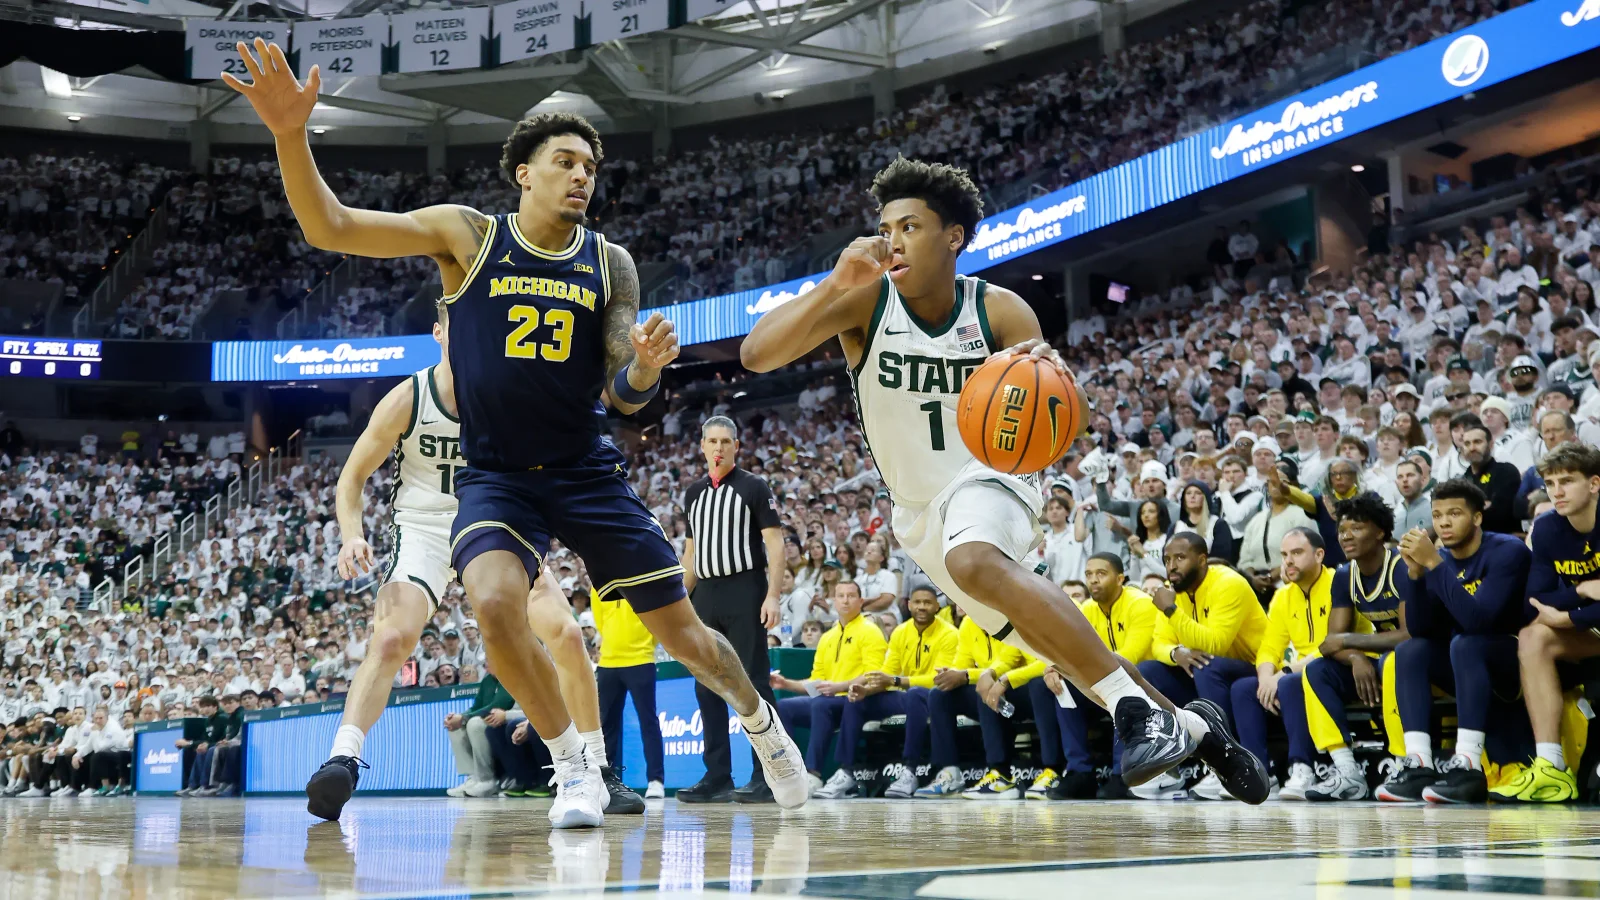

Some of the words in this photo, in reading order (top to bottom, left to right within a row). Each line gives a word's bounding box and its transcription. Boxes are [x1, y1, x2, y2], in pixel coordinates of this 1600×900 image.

[516, 1, 559, 19] SHAWN
[318, 26, 365, 38] MORRIS
[415, 18, 465, 31] MATEEN
[513, 13, 562, 33] RESPERT
[620, 14, 639, 33] 21
[199, 28, 276, 40] DRAYMOND
[413, 31, 467, 44] CLEAVES
[309, 39, 373, 52] PETERSON
[525, 34, 549, 54] 24
[328, 57, 353, 73] 42
[430, 50, 449, 66] 12
[1211, 80, 1379, 159] Auto-Owners
[1242, 116, 1344, 166] INSURANCE
[966, 194, 1086, 253] Auto-Owners
[988, 222, 1062, 261] INSURANCE
[488, 276, 597, 312] MICHIGAN
[505, 304, 575, 362] 23
[273, 343, 405, 364] Auto-Owners
[10, 361, 21, 374] 0
[44, 361, 56, 375] 0
[80, 363, 91, 376] 0
[299, 362, 379, 375] INSURANCE
[920, 400, 946, 451] 1
[997, 385, 1029, 452] ELITE
[664, 740, 705, 756] INSURA
